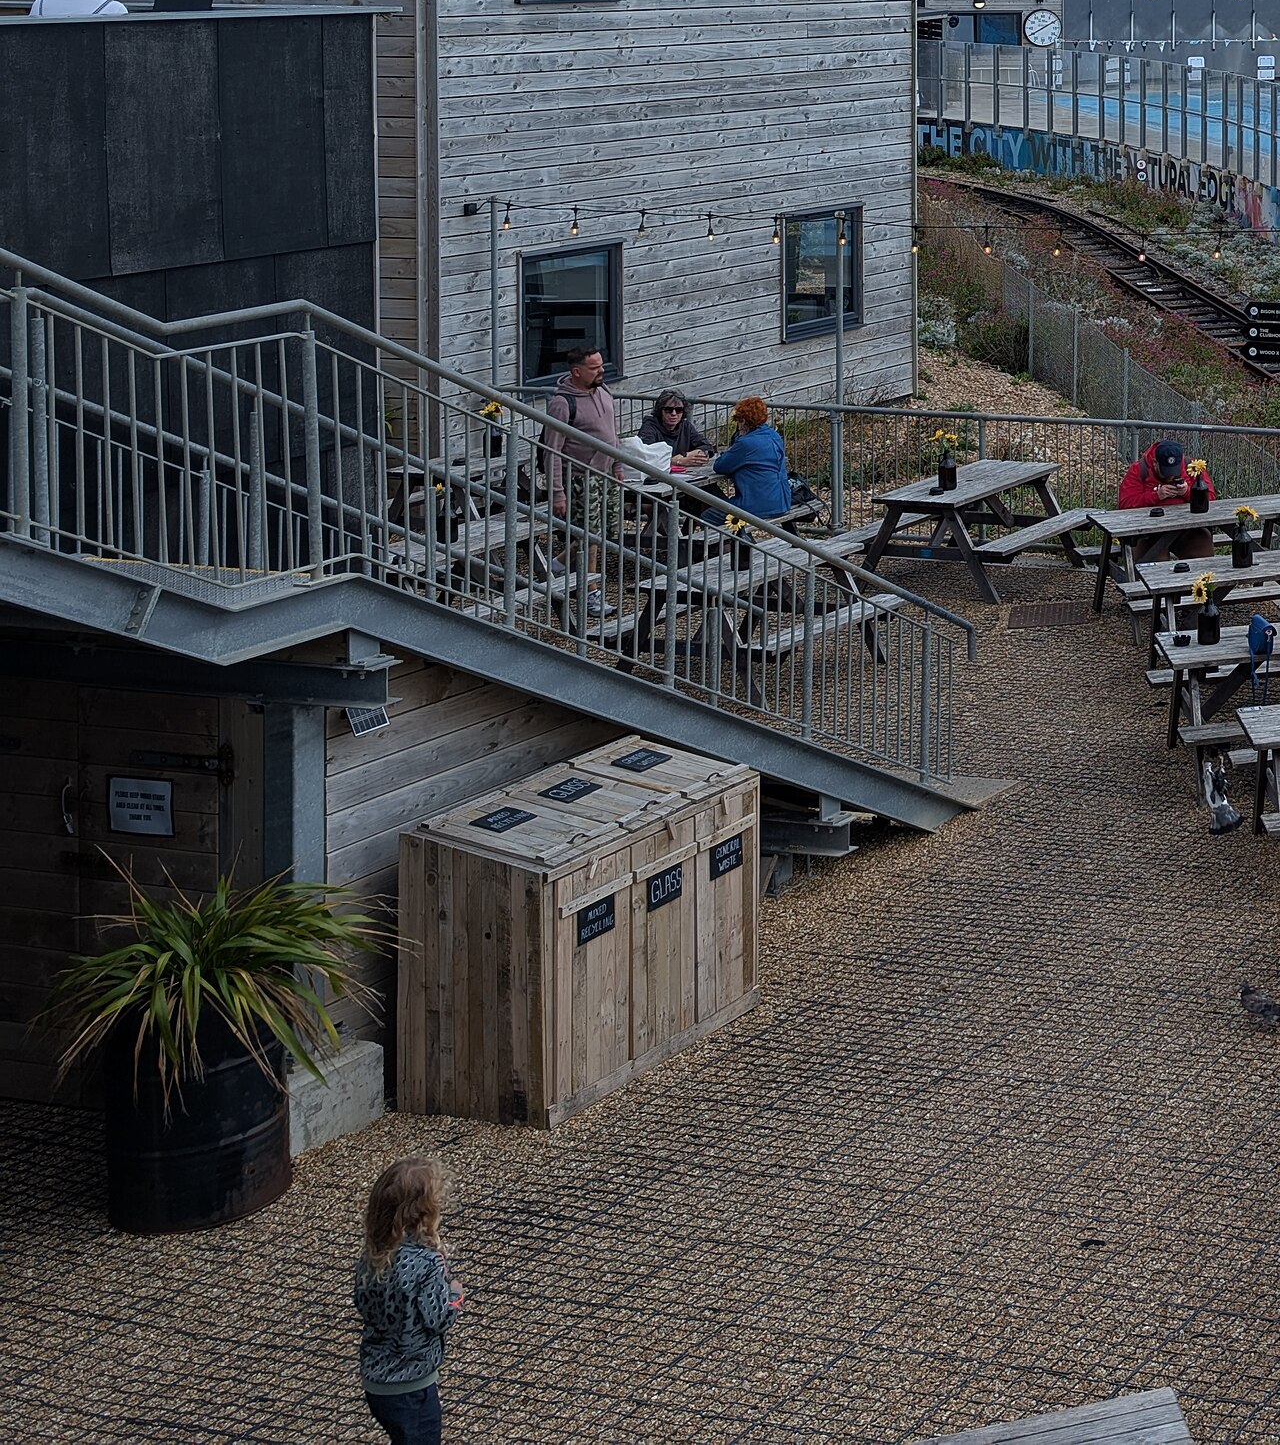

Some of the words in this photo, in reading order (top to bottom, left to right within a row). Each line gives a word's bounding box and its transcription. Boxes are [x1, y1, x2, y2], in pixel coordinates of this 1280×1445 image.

[917, 124, 962, 157] THE
[969, 127, 1024, 167] CITY
[548, 779, 591, 799] GLASS
[487, 811, 511, 823] MIXED
[715, 838, 741, 858] GENERAL
[718, 854, 737, 872] WASTE
[650, 867, 682, 903] GLASS
[587, 903, 607, 921] MIXED
[580, 913, 614, 940] RECYCLING
